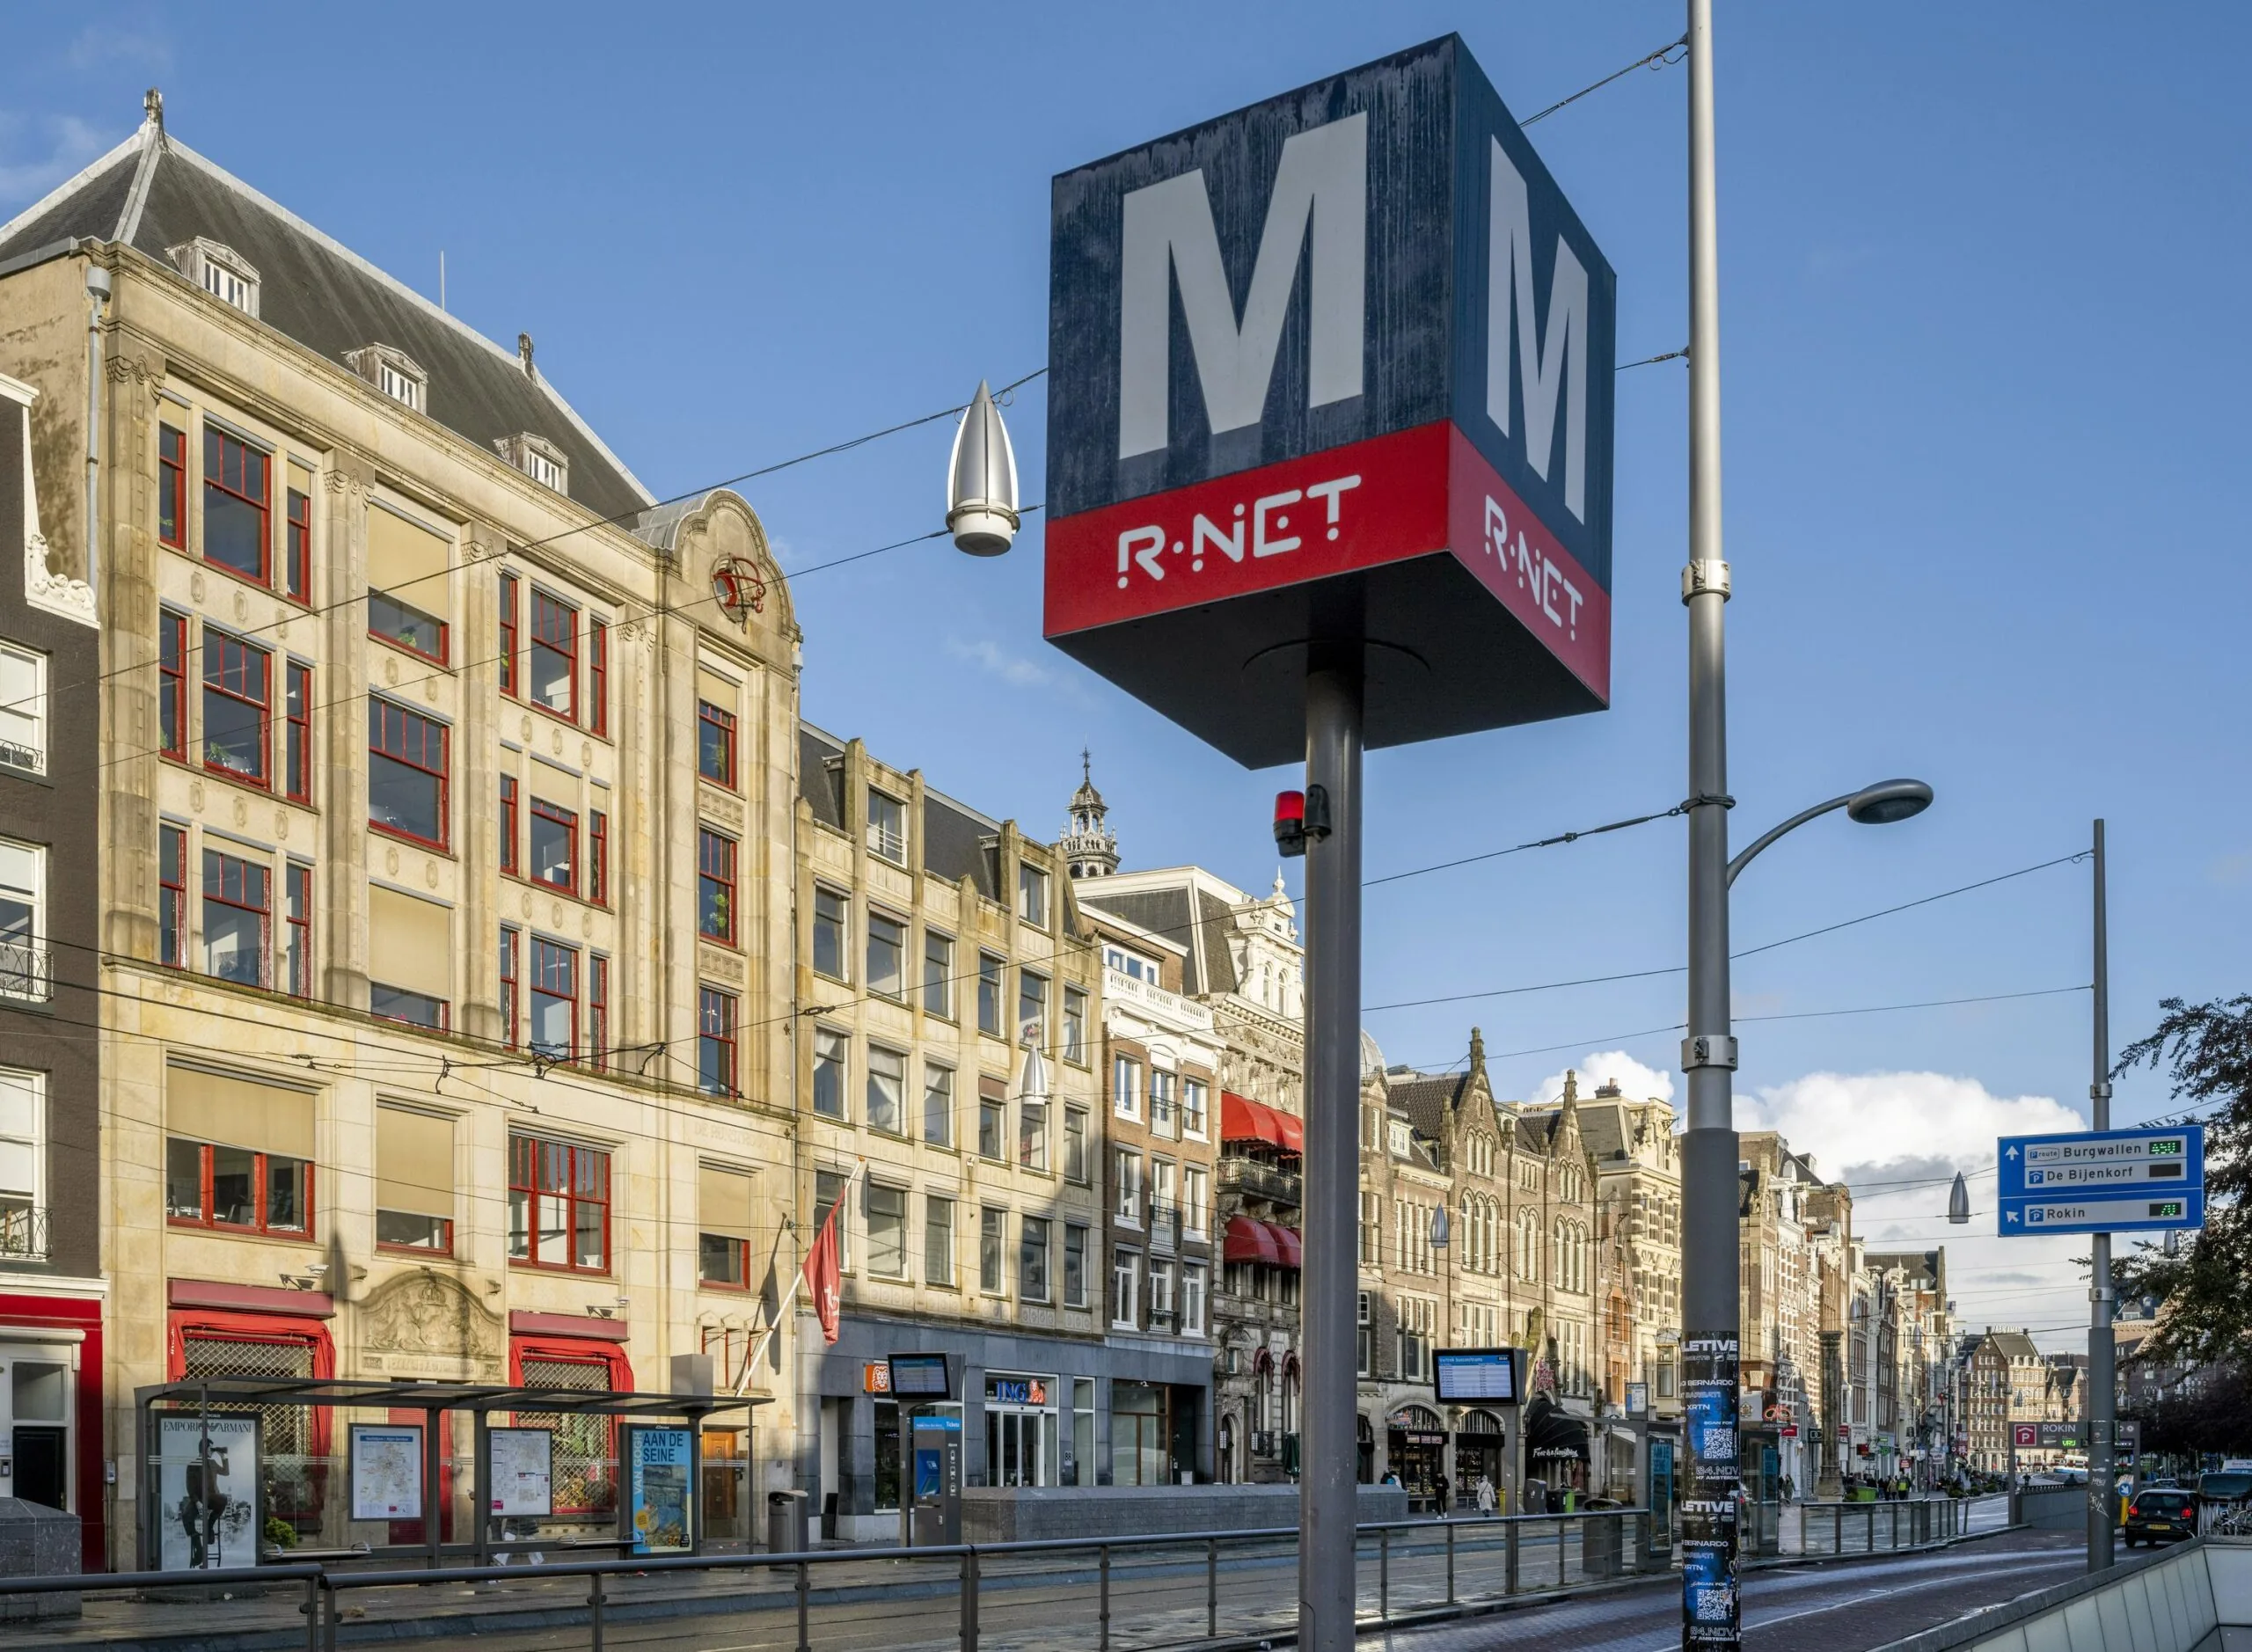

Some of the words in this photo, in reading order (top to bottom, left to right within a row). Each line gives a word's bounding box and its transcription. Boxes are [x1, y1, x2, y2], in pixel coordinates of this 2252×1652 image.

[1119, 111, 1367, 460] M
[1486, 133, 1589, 526] M
[2064, 1144, 2142, 1159] Burgwallen
[2047, 1171, 2063, 1181] De
[2069, 1166, 2133, 1182] Bijenkorf
[2047, 1207, 2086, 1219] Rokin
[996, 1380, 1027, 1402] ING
[217, 1422, 252, 1433] ARMANI
[2043, 1424, 2076, 1433] ROKIN
[643, 1432, 666, 1447] AAN
[669, 1433, 684, 1447] DE
[633, 1432, 642, 1467] GOGH
[643, 1448, 675, 1462] SEINE
[633, 1471, 642, 1495] VAN
